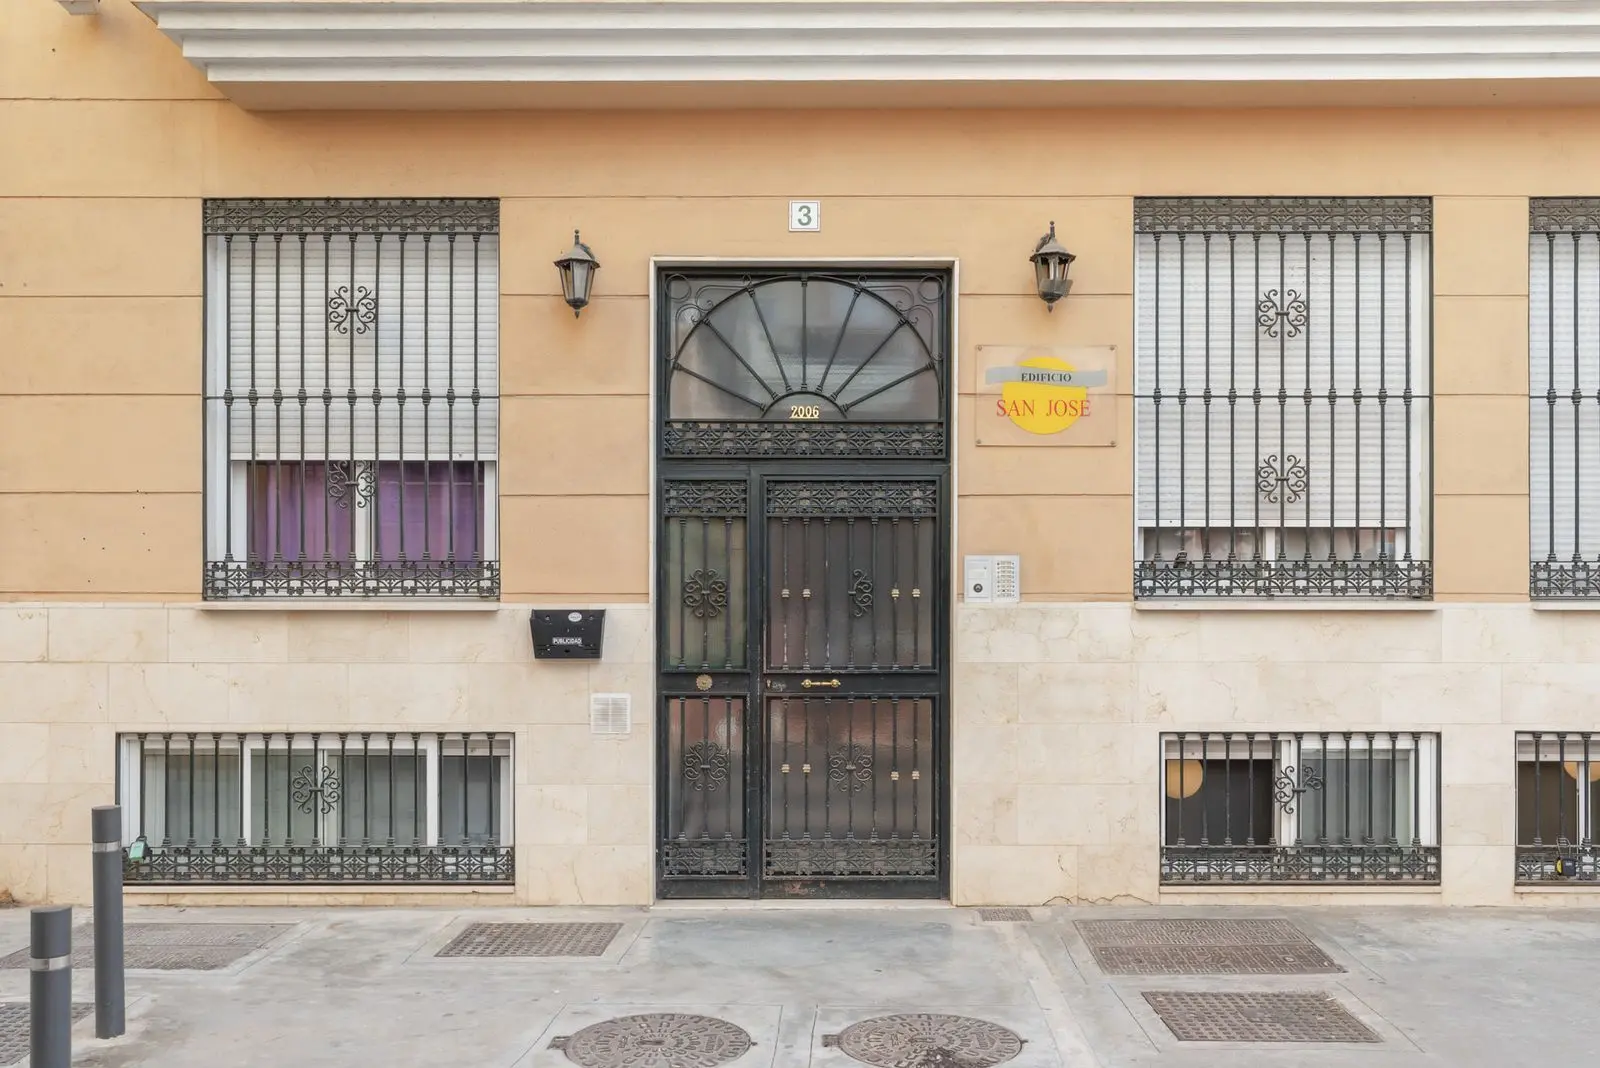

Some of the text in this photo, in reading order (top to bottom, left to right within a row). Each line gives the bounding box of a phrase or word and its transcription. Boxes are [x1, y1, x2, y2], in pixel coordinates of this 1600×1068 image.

[798, 205, 812, 226] 3
[1021, 372, 1072, 382] EDIFICIO
[791, 405, 819, 418] 2006
[996, 399, 1035, 417] SAN
[552, 637, 582, 645] PUBLICIDAD
